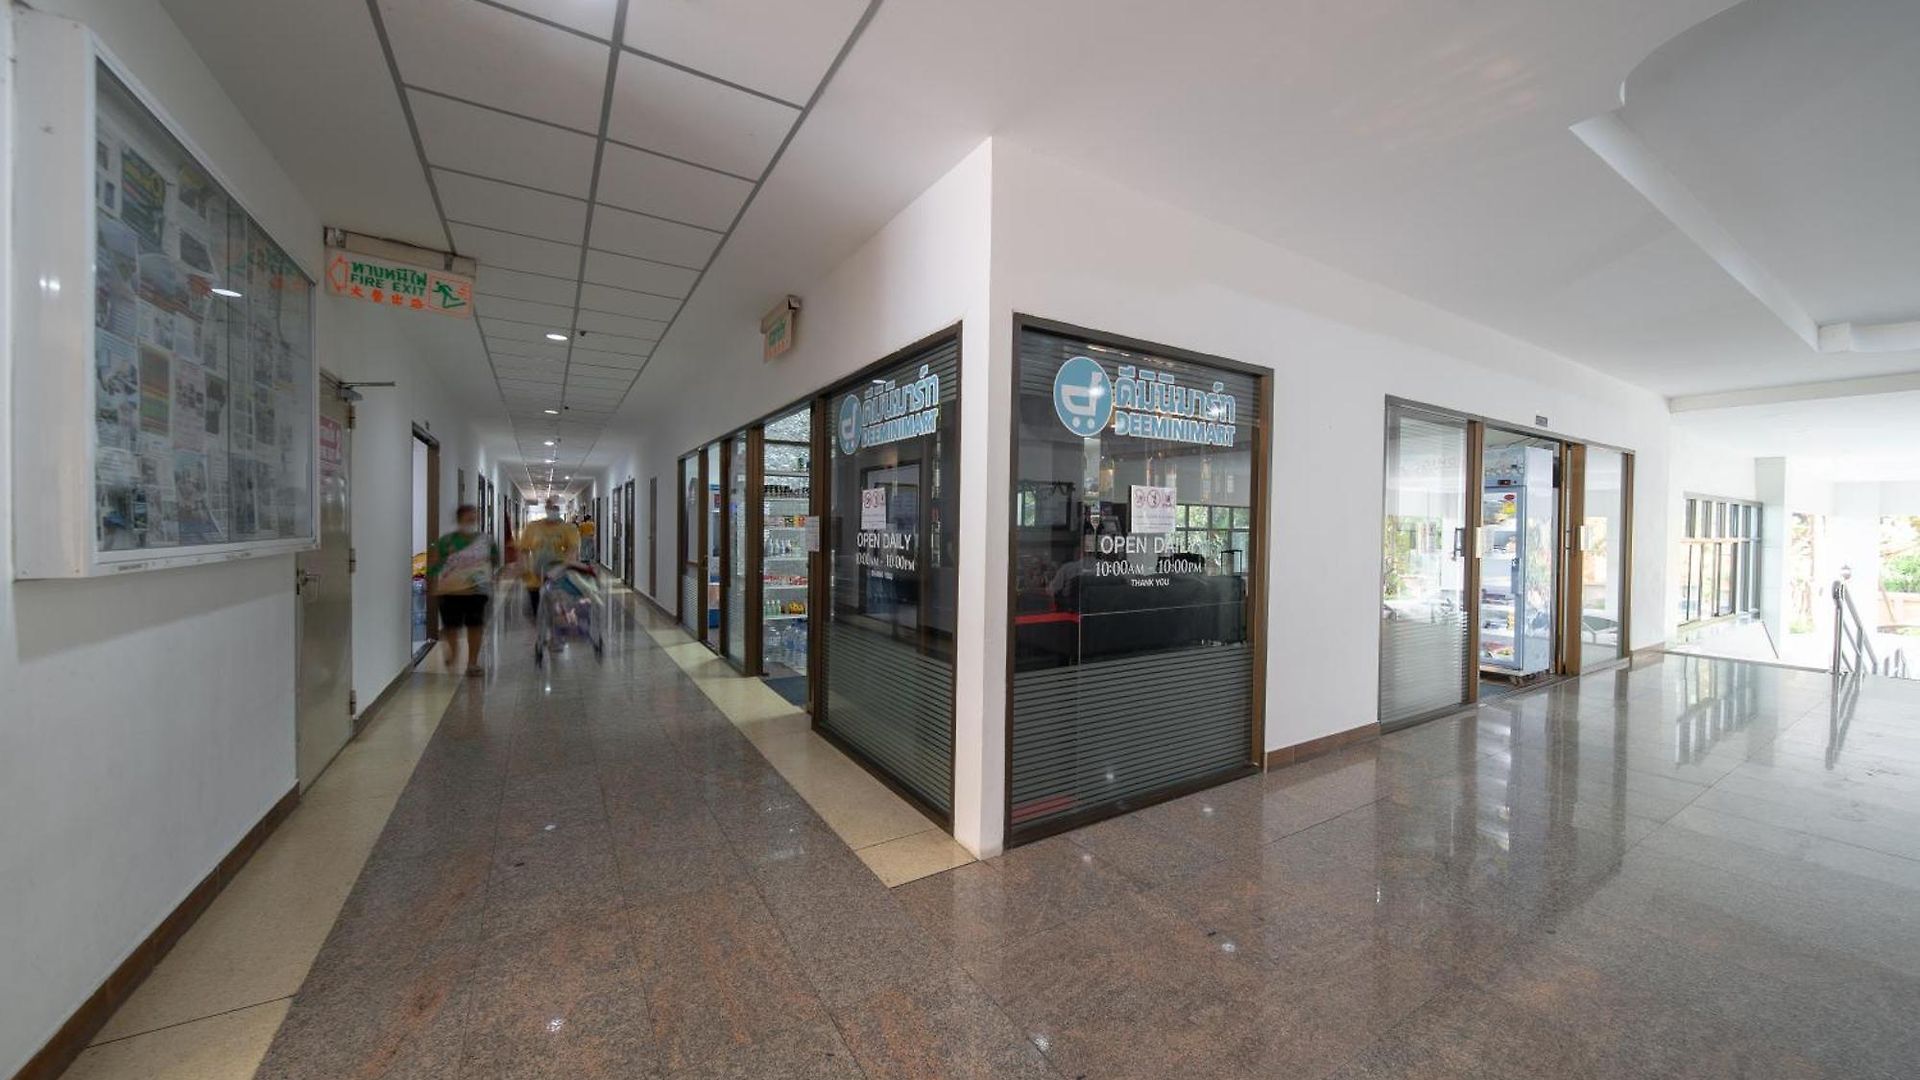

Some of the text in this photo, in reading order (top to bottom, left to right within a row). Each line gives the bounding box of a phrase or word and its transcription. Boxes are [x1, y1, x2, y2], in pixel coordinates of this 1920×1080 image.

[350, 273, 425, 296] FIRE EXIT
[861, 407, 939, 448] DEEMINIMART
[1114, 410, 1236, 447] DEEMINIMART
[856, 532, 912, 551] OPEN DAILY
[1100, 535, 1148, 554] OPEN
[1159, 558, 1202, 574] 10:00PM
[1131, 578, 1170, 587] THANK YOU
